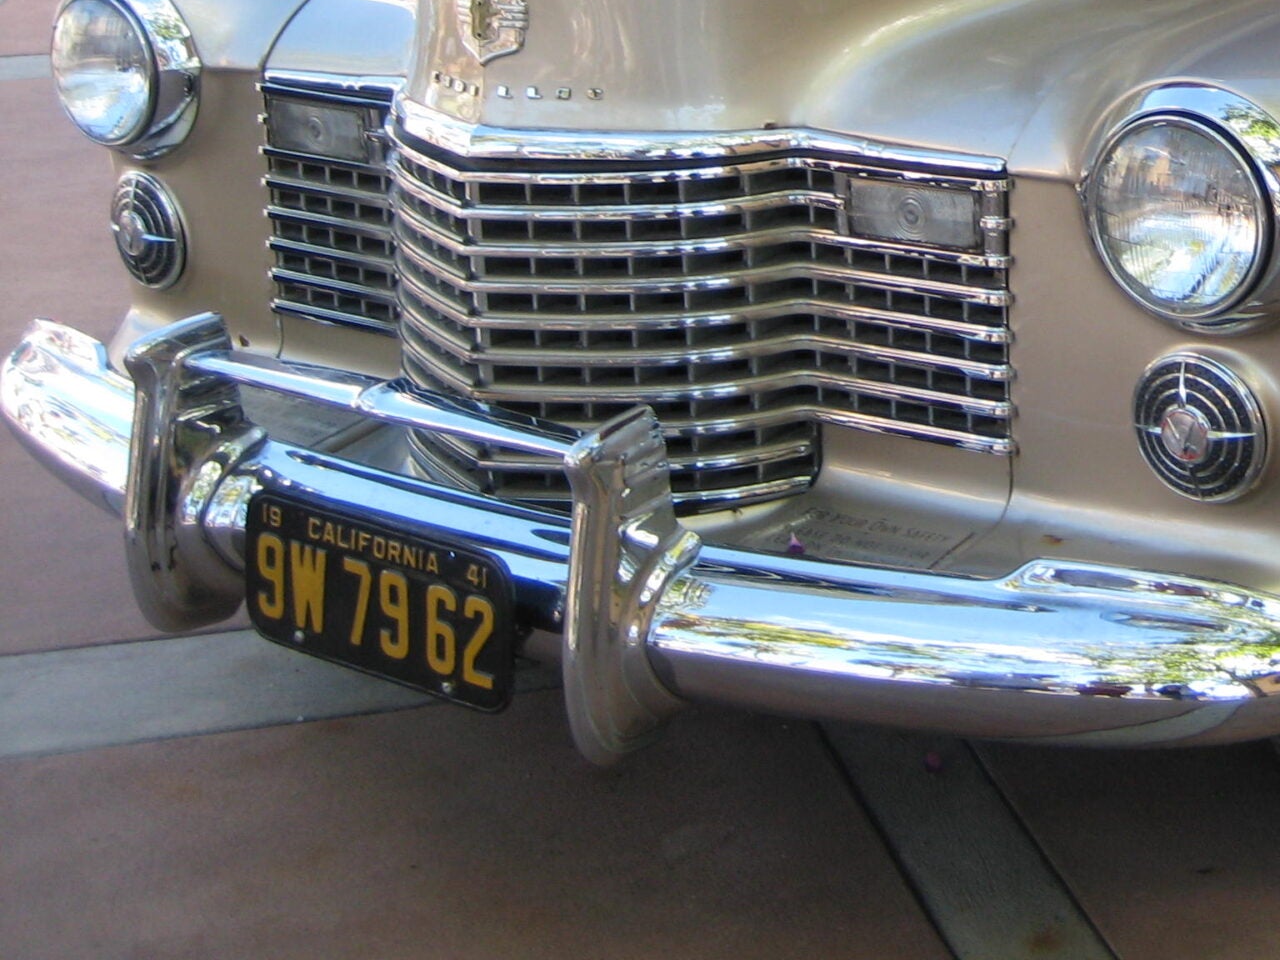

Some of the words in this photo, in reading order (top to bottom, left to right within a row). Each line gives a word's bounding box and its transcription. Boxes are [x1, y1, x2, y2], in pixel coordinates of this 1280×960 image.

[261, 503, 282, 528] 19
[308, 516, 439, 574] CALIFORNIA
[466, 564, 489, 588] 41
